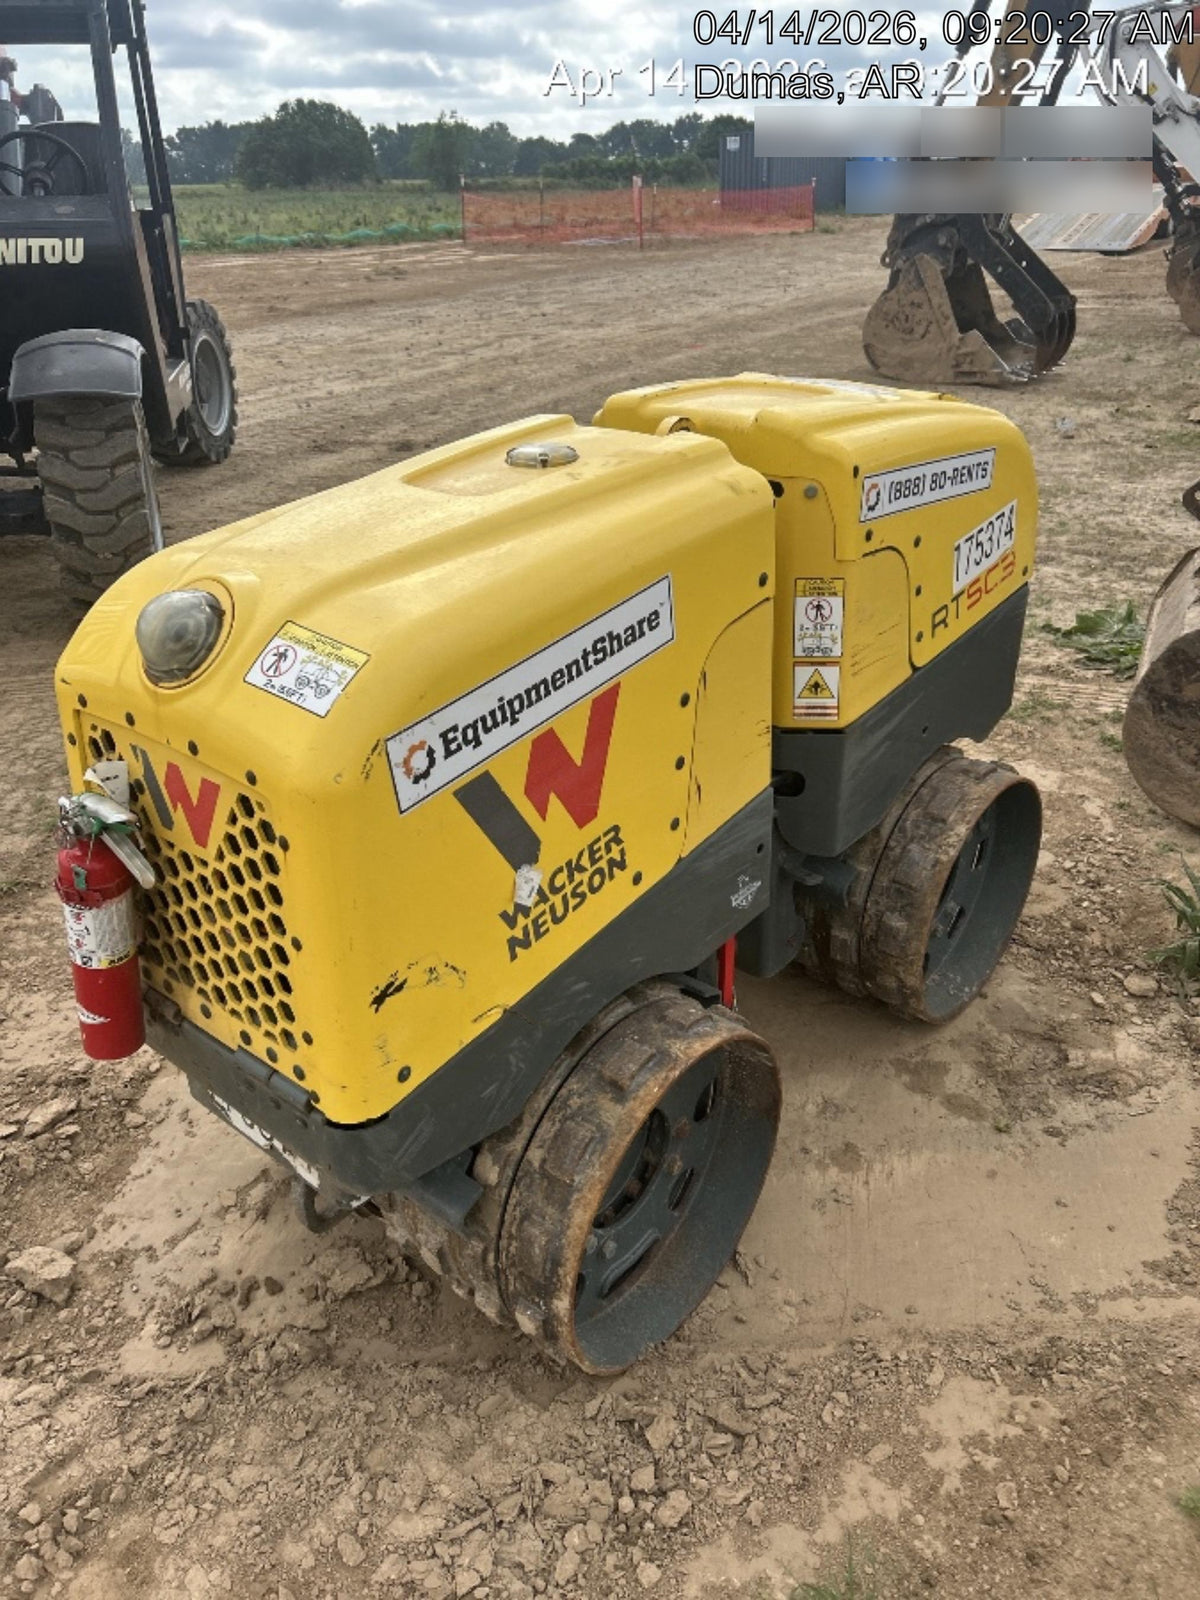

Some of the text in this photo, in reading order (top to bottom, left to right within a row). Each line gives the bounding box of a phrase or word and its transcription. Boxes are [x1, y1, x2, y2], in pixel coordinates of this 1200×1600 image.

[0, 237, 84, 265] NITOU
[888, 460, 989, 504] (888) 80-RENTS
[954, 504, 1014, 582] 175374
[439, 607, 661, 762] EquipmentShare
[498, 824, 625, 930] WACKER
[506, 847, 627, 963] NEUSON
